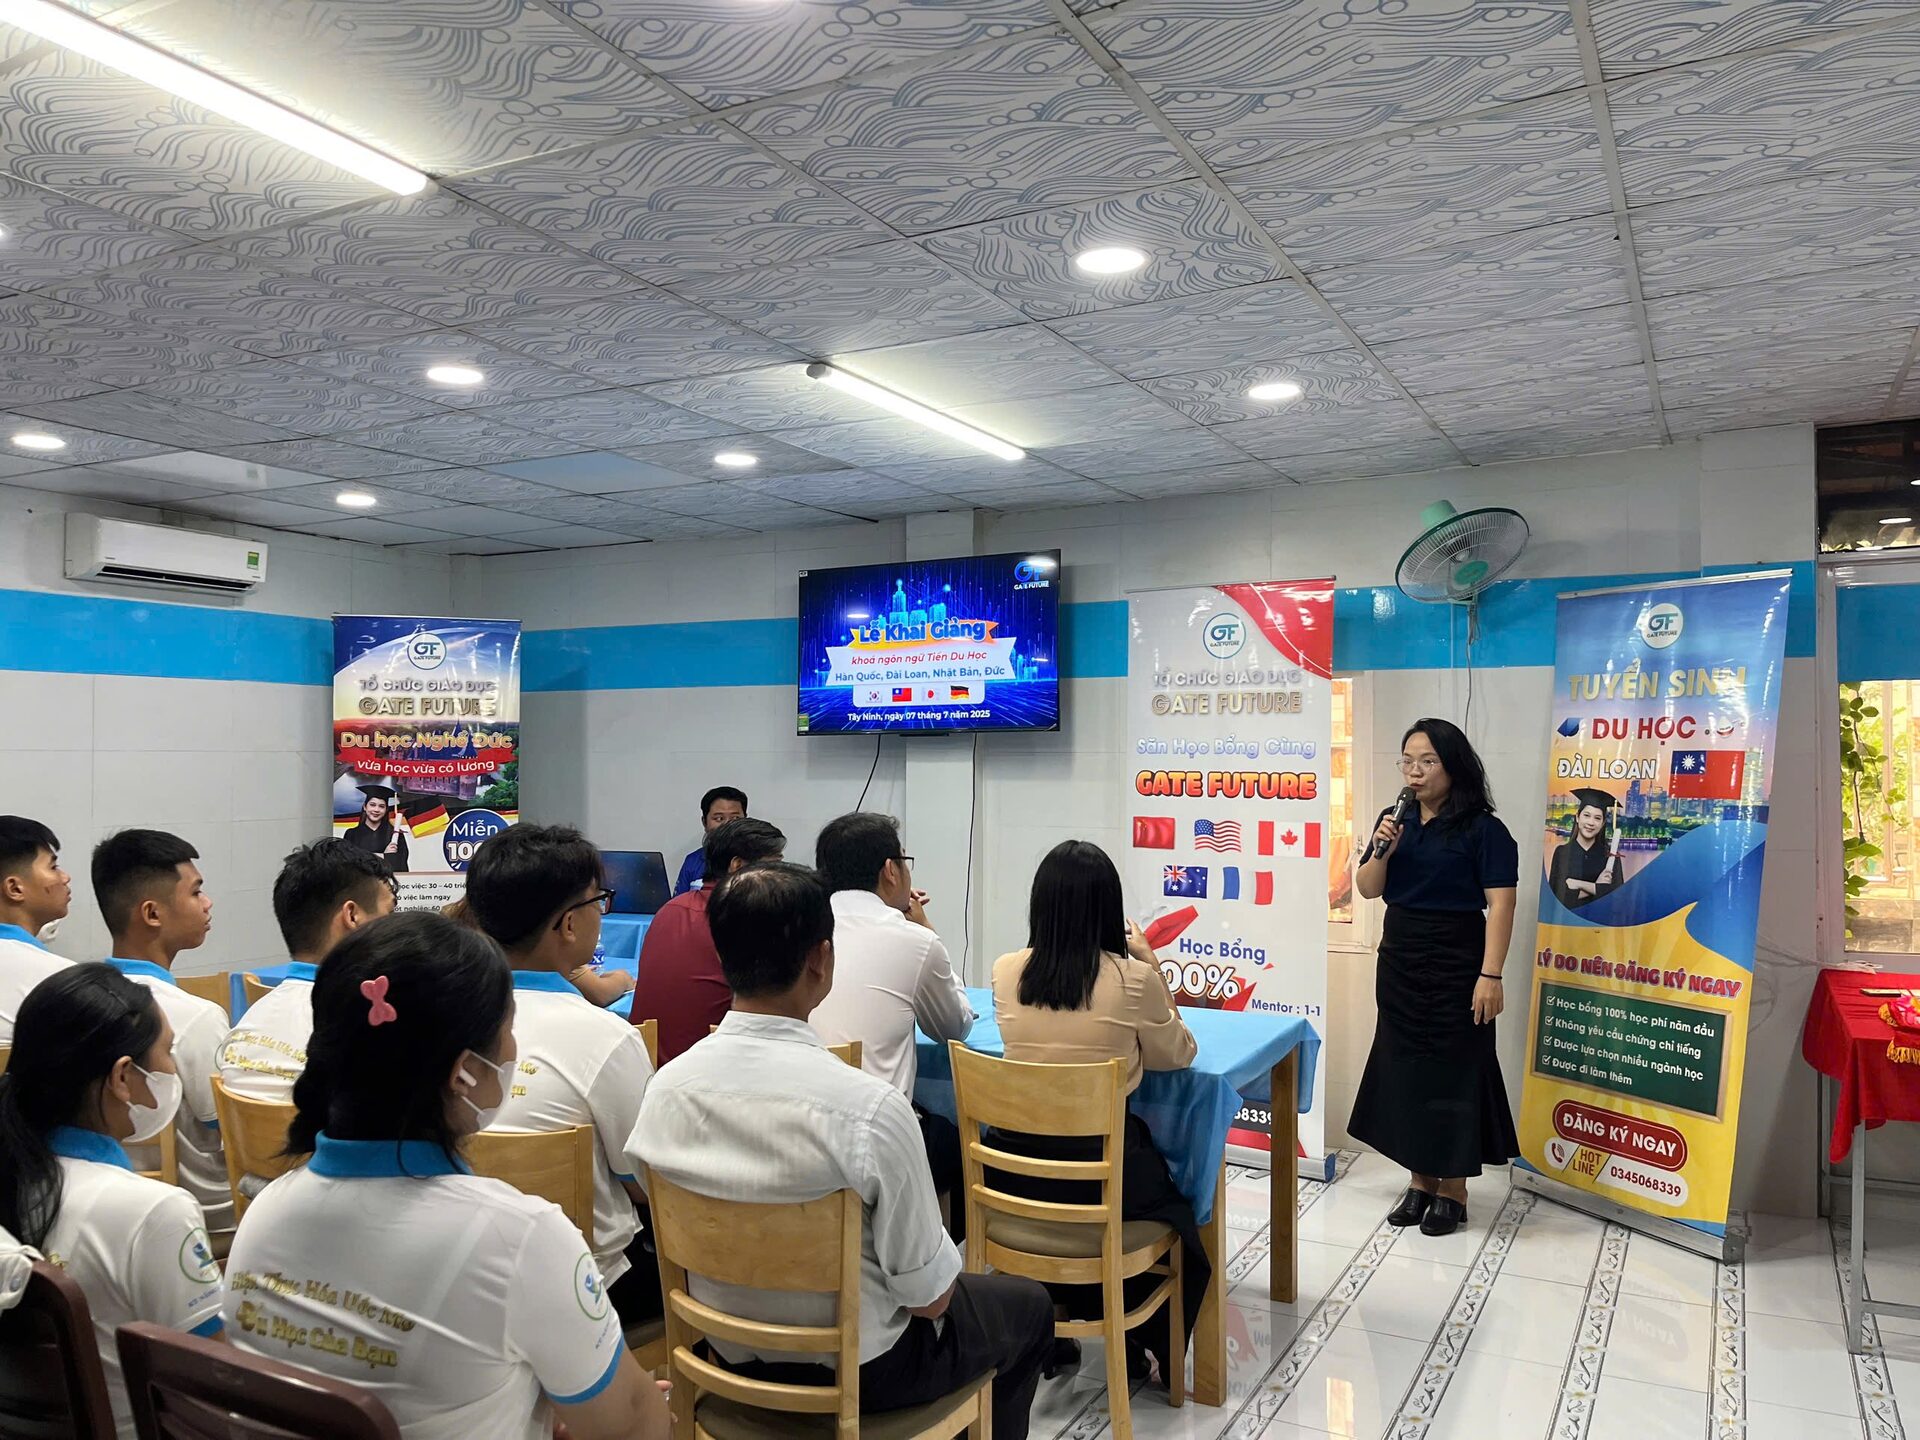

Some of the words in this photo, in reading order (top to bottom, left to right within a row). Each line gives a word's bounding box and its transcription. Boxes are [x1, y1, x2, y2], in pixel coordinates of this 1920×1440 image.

[858, 620, 881, 643] Lễ
[885, 620, 926, 642] Khai
[930, 616, 986, 642] Giảng
[1210, 624, 1239, 641] GF
[1648, 613, 1678, 631] GF
[414, 642, 440, 655] GF
[877, 654, 902, 665] ngôn
[951, 652, 964, 660] Du
[967, 651, 987, 661] Học
[835, 672, 853, 681] Hàn
[856, 669, 883, 681] Quốc,
[886, 669, 902, 679] Đài
[905, 669, 930, 679] Loan,
[960, 666, 982, 677] Bản,
[985, 665, 1005, 675] Đức
[1568, 657, 1659, 700] TUYỂN
[359, 697, 414, 715] GATE
[421, 697, 497, 716] FUTURE
[1152, 692, 1209, 715] GATE
[1216, 691, 1303, 715] FUTURE
[848, 712, 862, 722] Tây
[862, 712, 884, 721] Ninh,
[884, 711, 904, 722] ngày
[905, 712, 916, 720] 07
[917, 711, 942, 720] tháng
[943, 711, 949, 719] 7
[950, 710, 969, 719] năm
[970, 709, 991, 718] 2025
[340, 731, 370, 748] Du
[374, 729, 412, 751] học
[472, 730, 513, 748] Đức
[1592, 717, 1629, 740] DU
[1637, 715, 1697, 746] HỌC
[1136, 736, 1168, 755] Săn
[1173, 738, 1209, 759] Học
[1265, 737, 1316, 759] Cùng
[358, 758, 381, 771] vừa
[385, 762, 410, 775] học
[413, 762, 435, 773] vừa
[438, 763, 453, 773] có
[457, 760, 495, 773] lương
[1557, 754, 1592, 779] ĐÀI
[1598, 758, 1657, 779] LOAN
[1136, 770, 1203, 797] GATE
[1207, 770, 1317, 800] FUTURE
[452, 819, 498, 837] Miễn
[1179, 937, 1213, 958] Học
[1219, 938, 1266, 965] Bổng
[1159, 959, 1240, 999] 00%
[1554, 953, 1578, 972] DO
[1580, 955, 1613, 978] NÊN
[1614, 960, 1660, 986] ĐĂNG
[1663, 968, 1687, 990] KÝ
[1688, 974, 1742, 999] NGAY
[1251, 998, 1293, 1013] Mentor
[1304, 1004, 1321, 1016] 1-1
[1556, 998, 1576, 1011] Học
[1605, 1007, 1627, 1020] 100%
[1629, 1011, 1648, 1025] học
[1651, 1017, 1668, 1027] phí
[1669, 1020, 1691, 1032] năm
[1555, 1018, 1585, 1035] Không
[1588, 1025, 1604, 1036] yêu
[1625, 1033, 1656, 1050] chứng
[1676, 1042, 1702, 1059] tiếng
[1552, 1058, 1577, 1072] Được
[1590, 1066, 1607, 1078] làm
[1609, 1071, 1632, 1085] thêm
[1553, 1038, 1578, 1052] Được
[1581, 1044, 1595, 1056] lựa
[1597, 1049, 1619, 1062] chọn
[1650, 1061, 1682, 1076] ngành
[1684, 1067, 1703, 1081] học
[1563, 1112, 1605, 1136] ĐĂNG
[1609, 1125, 1629, 1143] KÝ
[1632, 1132, 1677, 1157] NGAY
[1572, 1159, 1595, 1176] LINE
[1580, 1149, 1601, 1165] HOT
[1610, 1166, 1681, 1197] 0345068339
